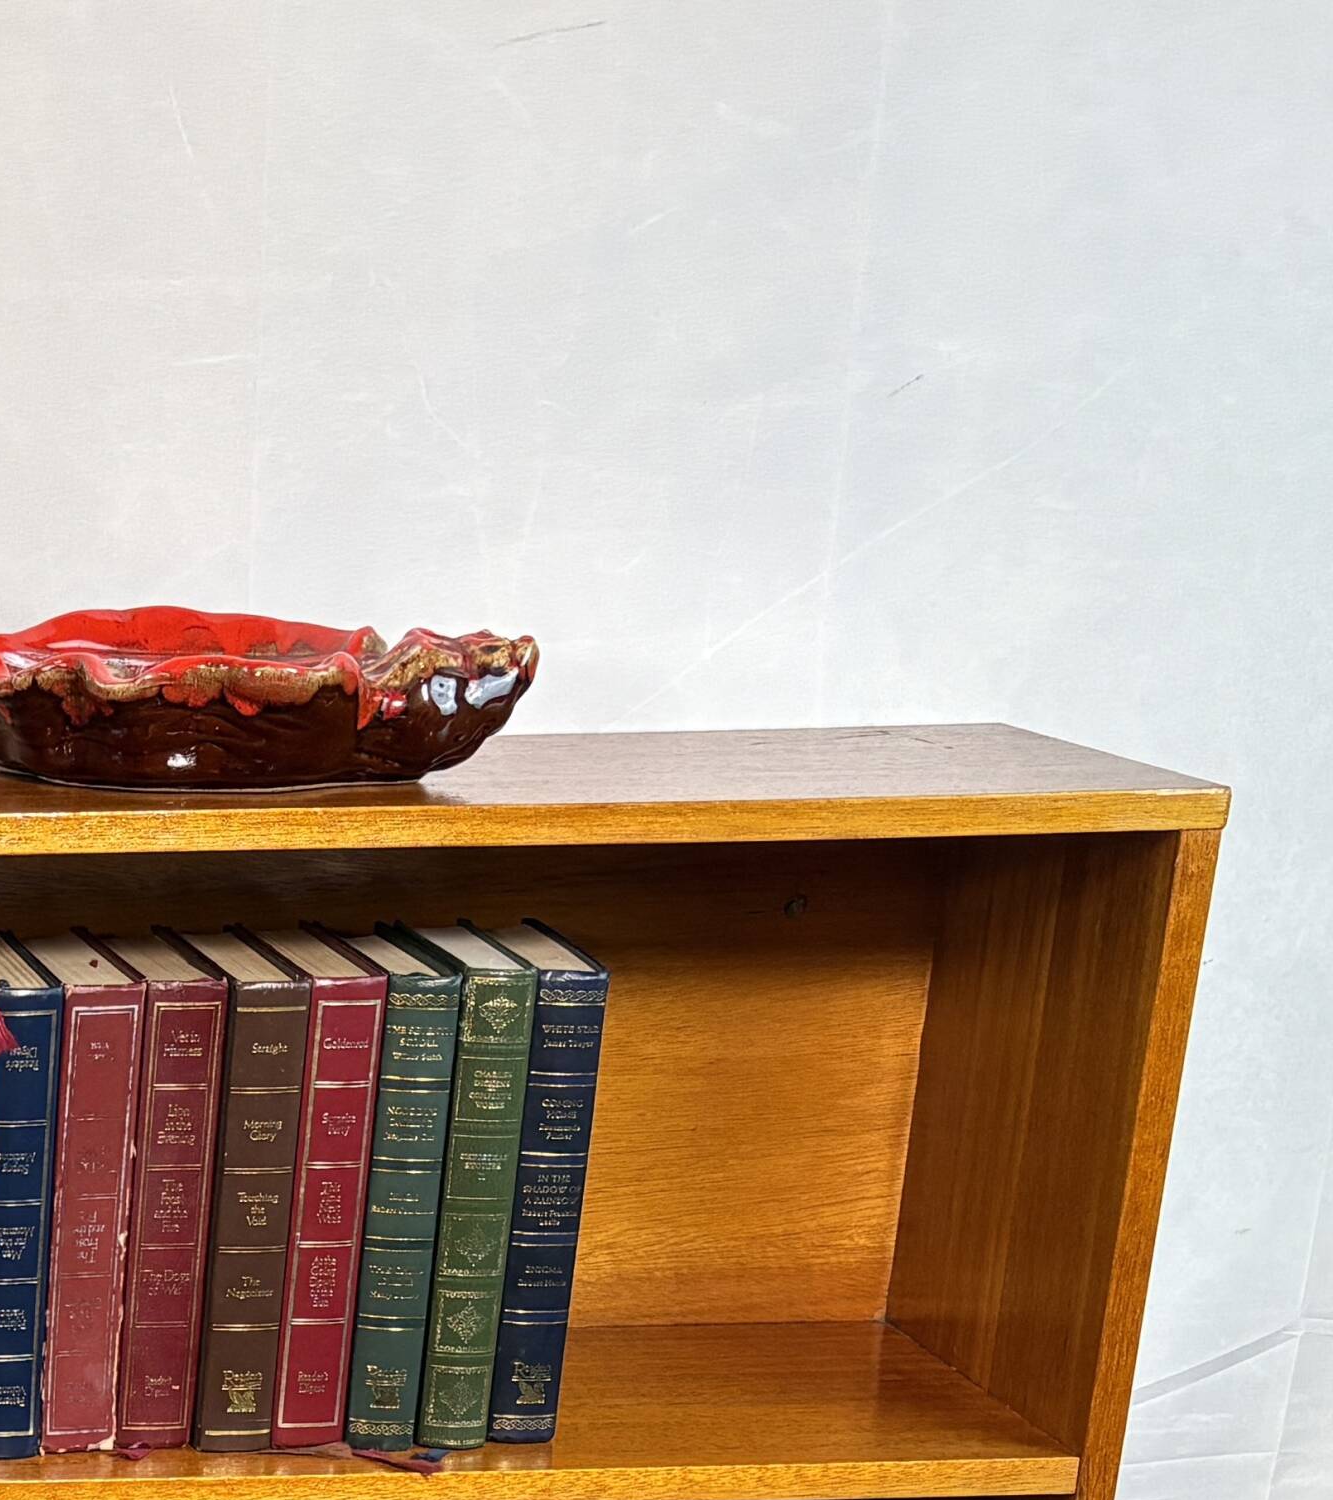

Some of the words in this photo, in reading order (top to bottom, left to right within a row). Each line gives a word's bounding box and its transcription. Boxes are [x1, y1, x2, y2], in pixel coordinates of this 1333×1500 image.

[252, 1042, 289, 1054] Straight
[242, 1120, 282, 1131] Morning
[248, 1131, 277, 1142] Glory
[538, 1173, 550, 1182] IN
[552, 1173, 572, 1183] THE
[236, 1192, 280, 1203] Touching
[250, 1205, 266, 1215] the
[246, 1216, 267, 1226] Void
[241, 1275, 261, 1287] The
